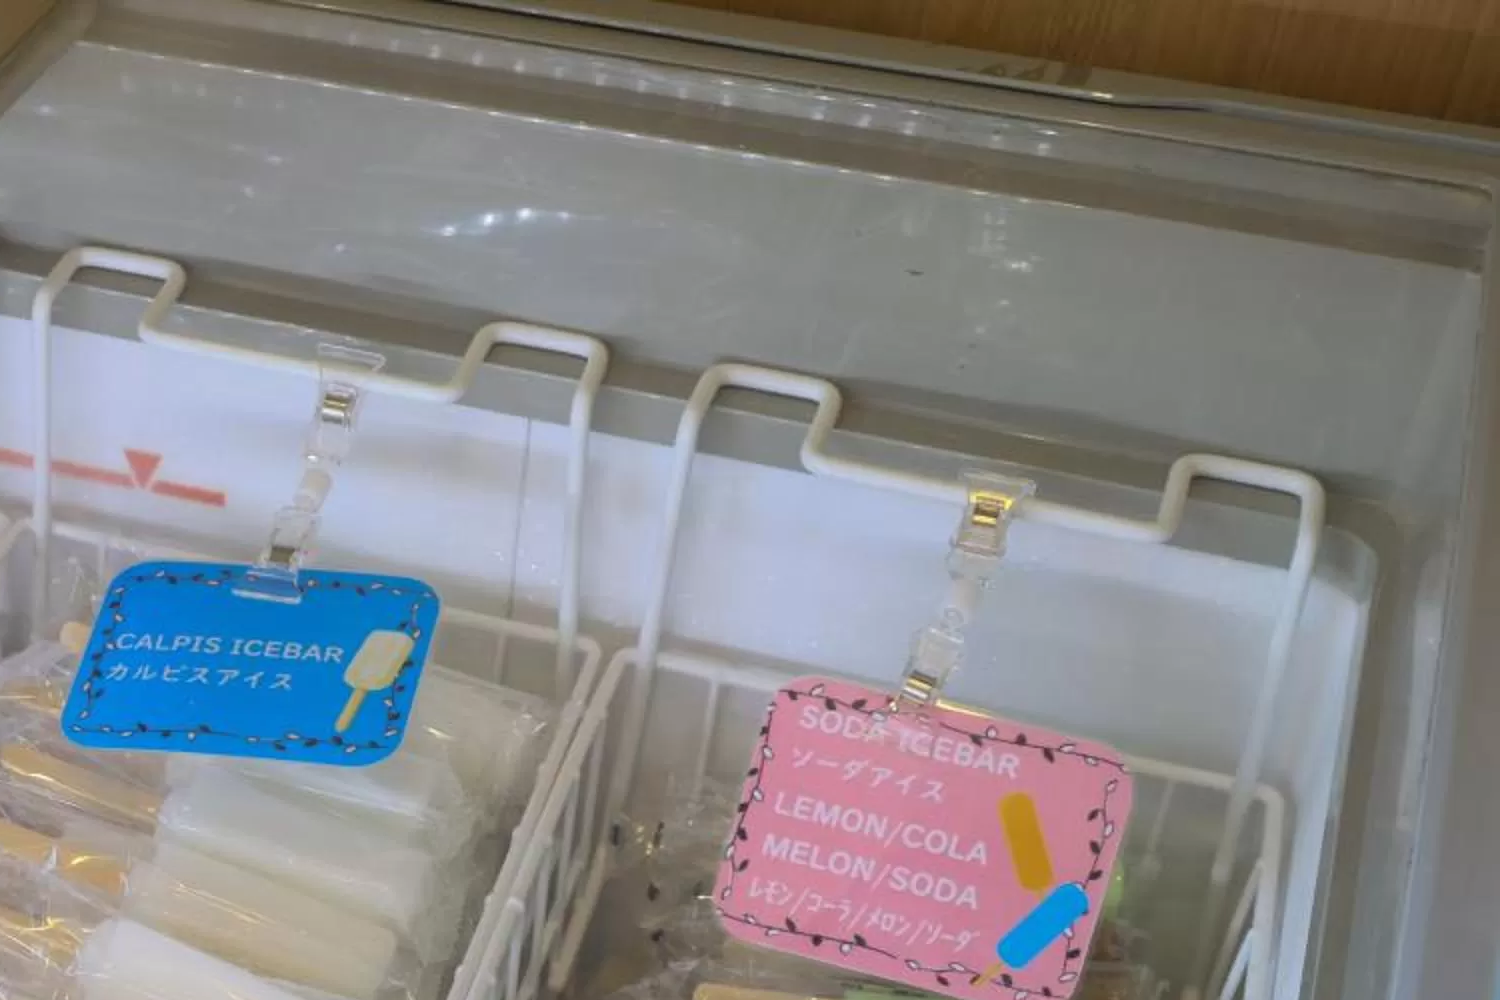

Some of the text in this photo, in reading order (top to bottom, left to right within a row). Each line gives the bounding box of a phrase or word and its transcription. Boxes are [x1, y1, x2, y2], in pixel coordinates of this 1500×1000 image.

[105, 661, 293, 691] カルピスアイス
[115, 631, 345, 664] CALPIS ICEBAR
[790, 746, 945, 804] ソーダアイス
[800, 704, 1021, 780] SODA ICEBAR
[773, 790, 989, 865] LEMON/COLA
[761, 833, 980, 911] MELON/SODA
